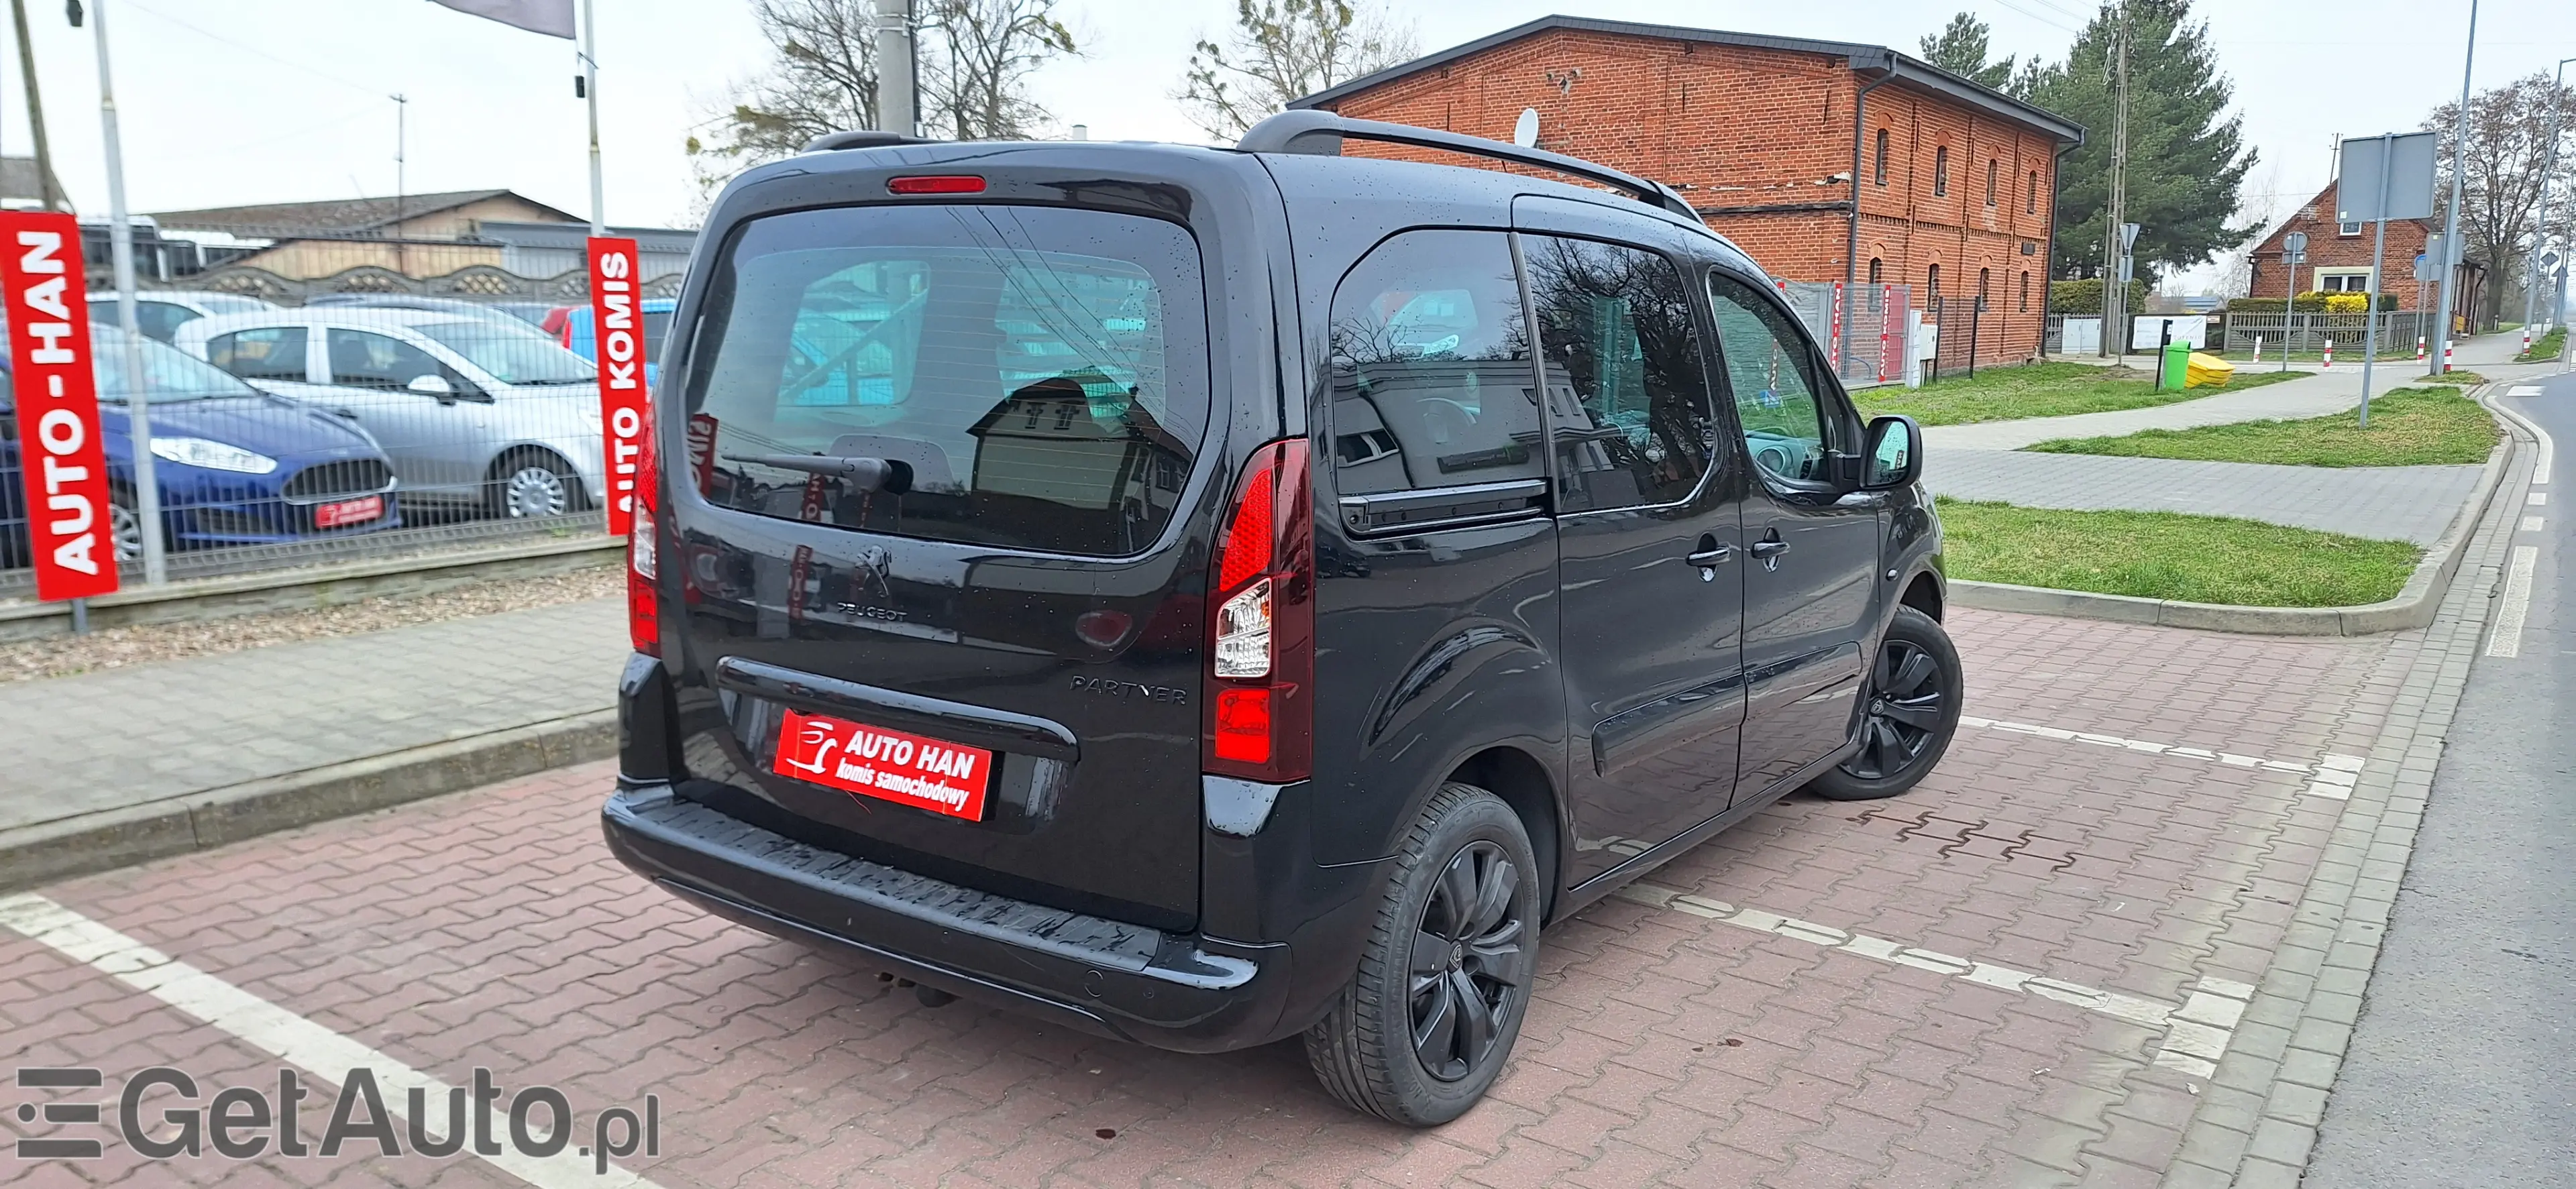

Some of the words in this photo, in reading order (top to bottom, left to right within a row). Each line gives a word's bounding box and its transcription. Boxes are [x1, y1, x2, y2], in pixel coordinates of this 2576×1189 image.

[17, 231, 74, 364] HAN
[600, 252, 636, 390] KOMIS
[39, 409, 98, 575] AUTO
[837, 602, 908, 622] PEUGEOT
[1069, 675, 1187, 705] PARTNER
[845, 730, 913, 765] AUTO
[916, 744, 975, 779] HAN
[836, 757, 875, 785] komis
[875, 771, 970, 812] samochodowy
